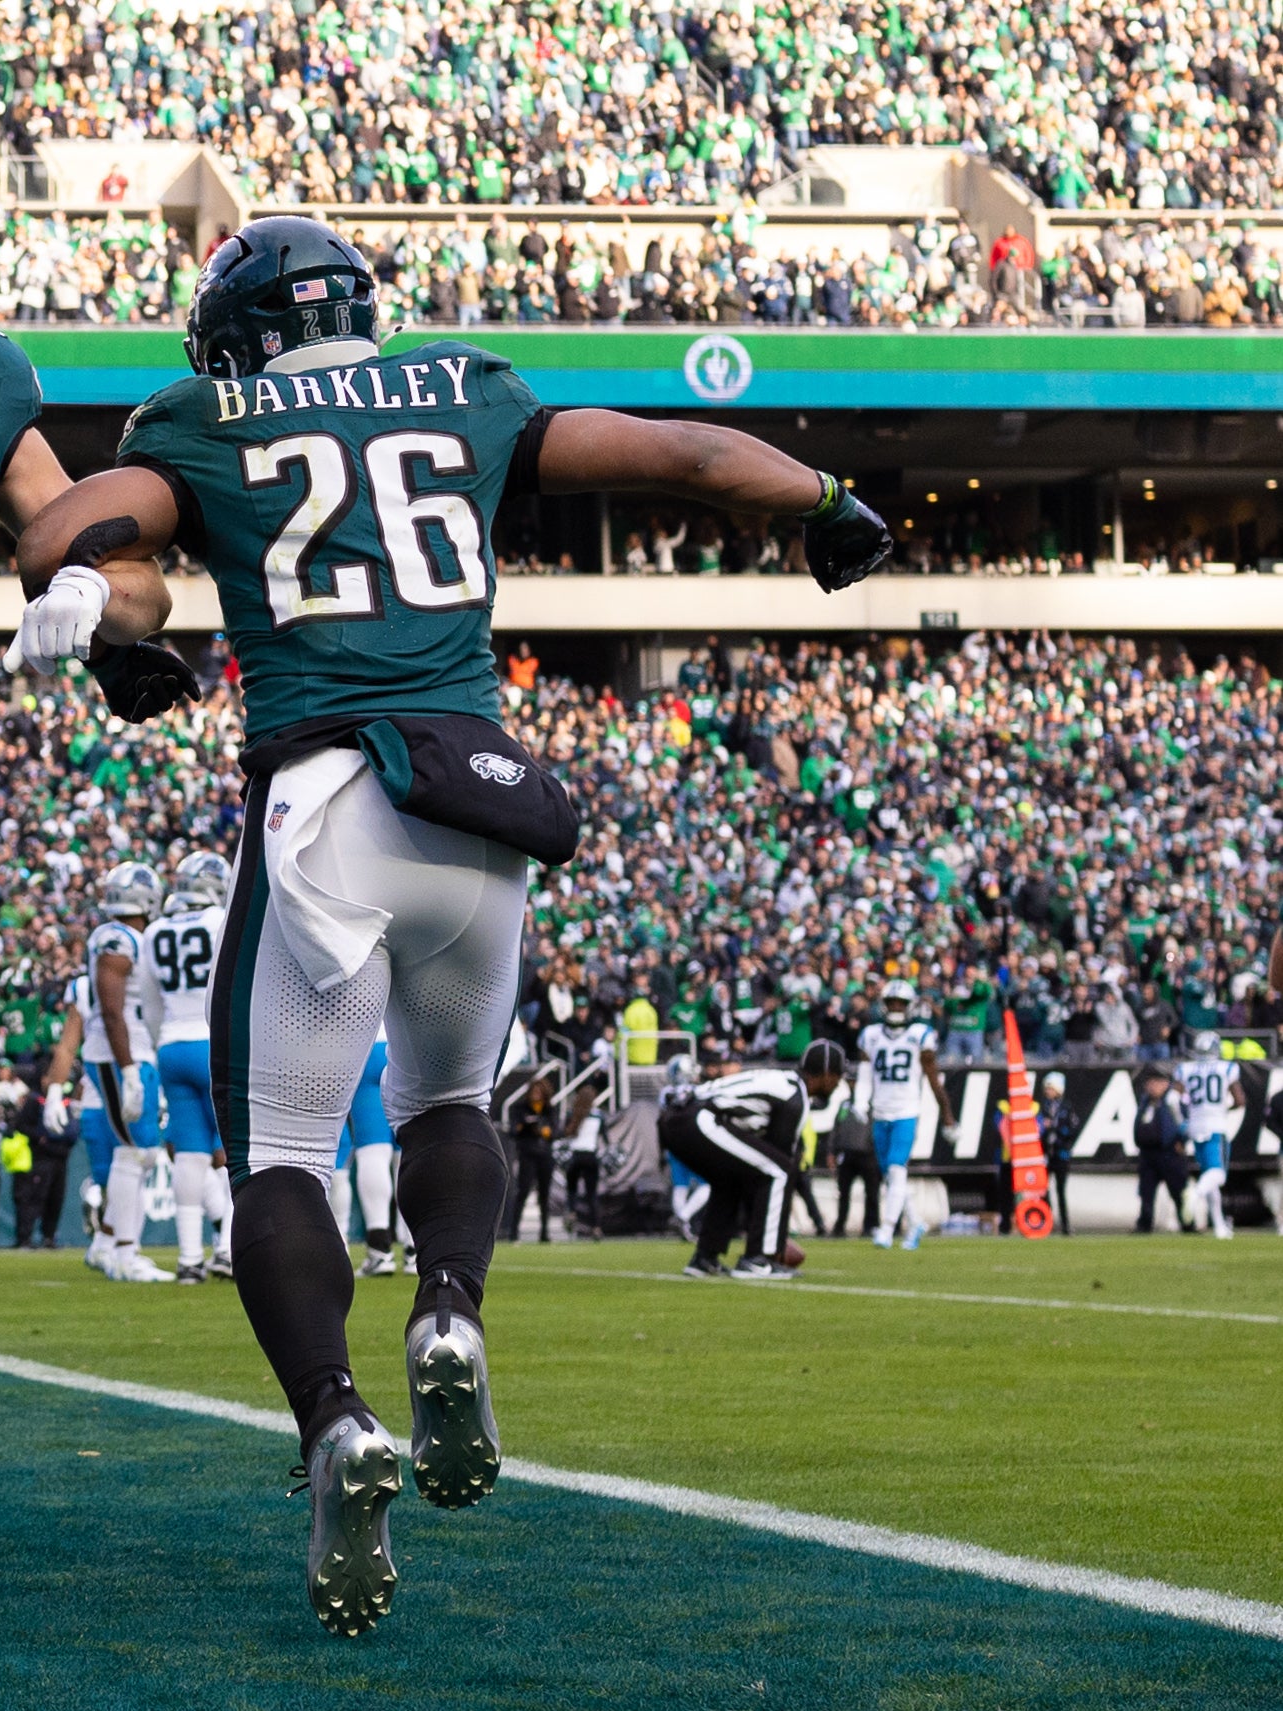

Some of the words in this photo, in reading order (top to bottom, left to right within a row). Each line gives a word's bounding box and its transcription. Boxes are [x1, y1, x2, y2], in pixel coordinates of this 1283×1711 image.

[301, 304, 352, 340] 26
[211, 356, 469, 423] BARKLEY
[241, 430, 486, 631] 26
[153, 926, 212, 992] 92
[874, 1048, 912, 1082] 42
[1187, 1073, 1223, 1106] 20
